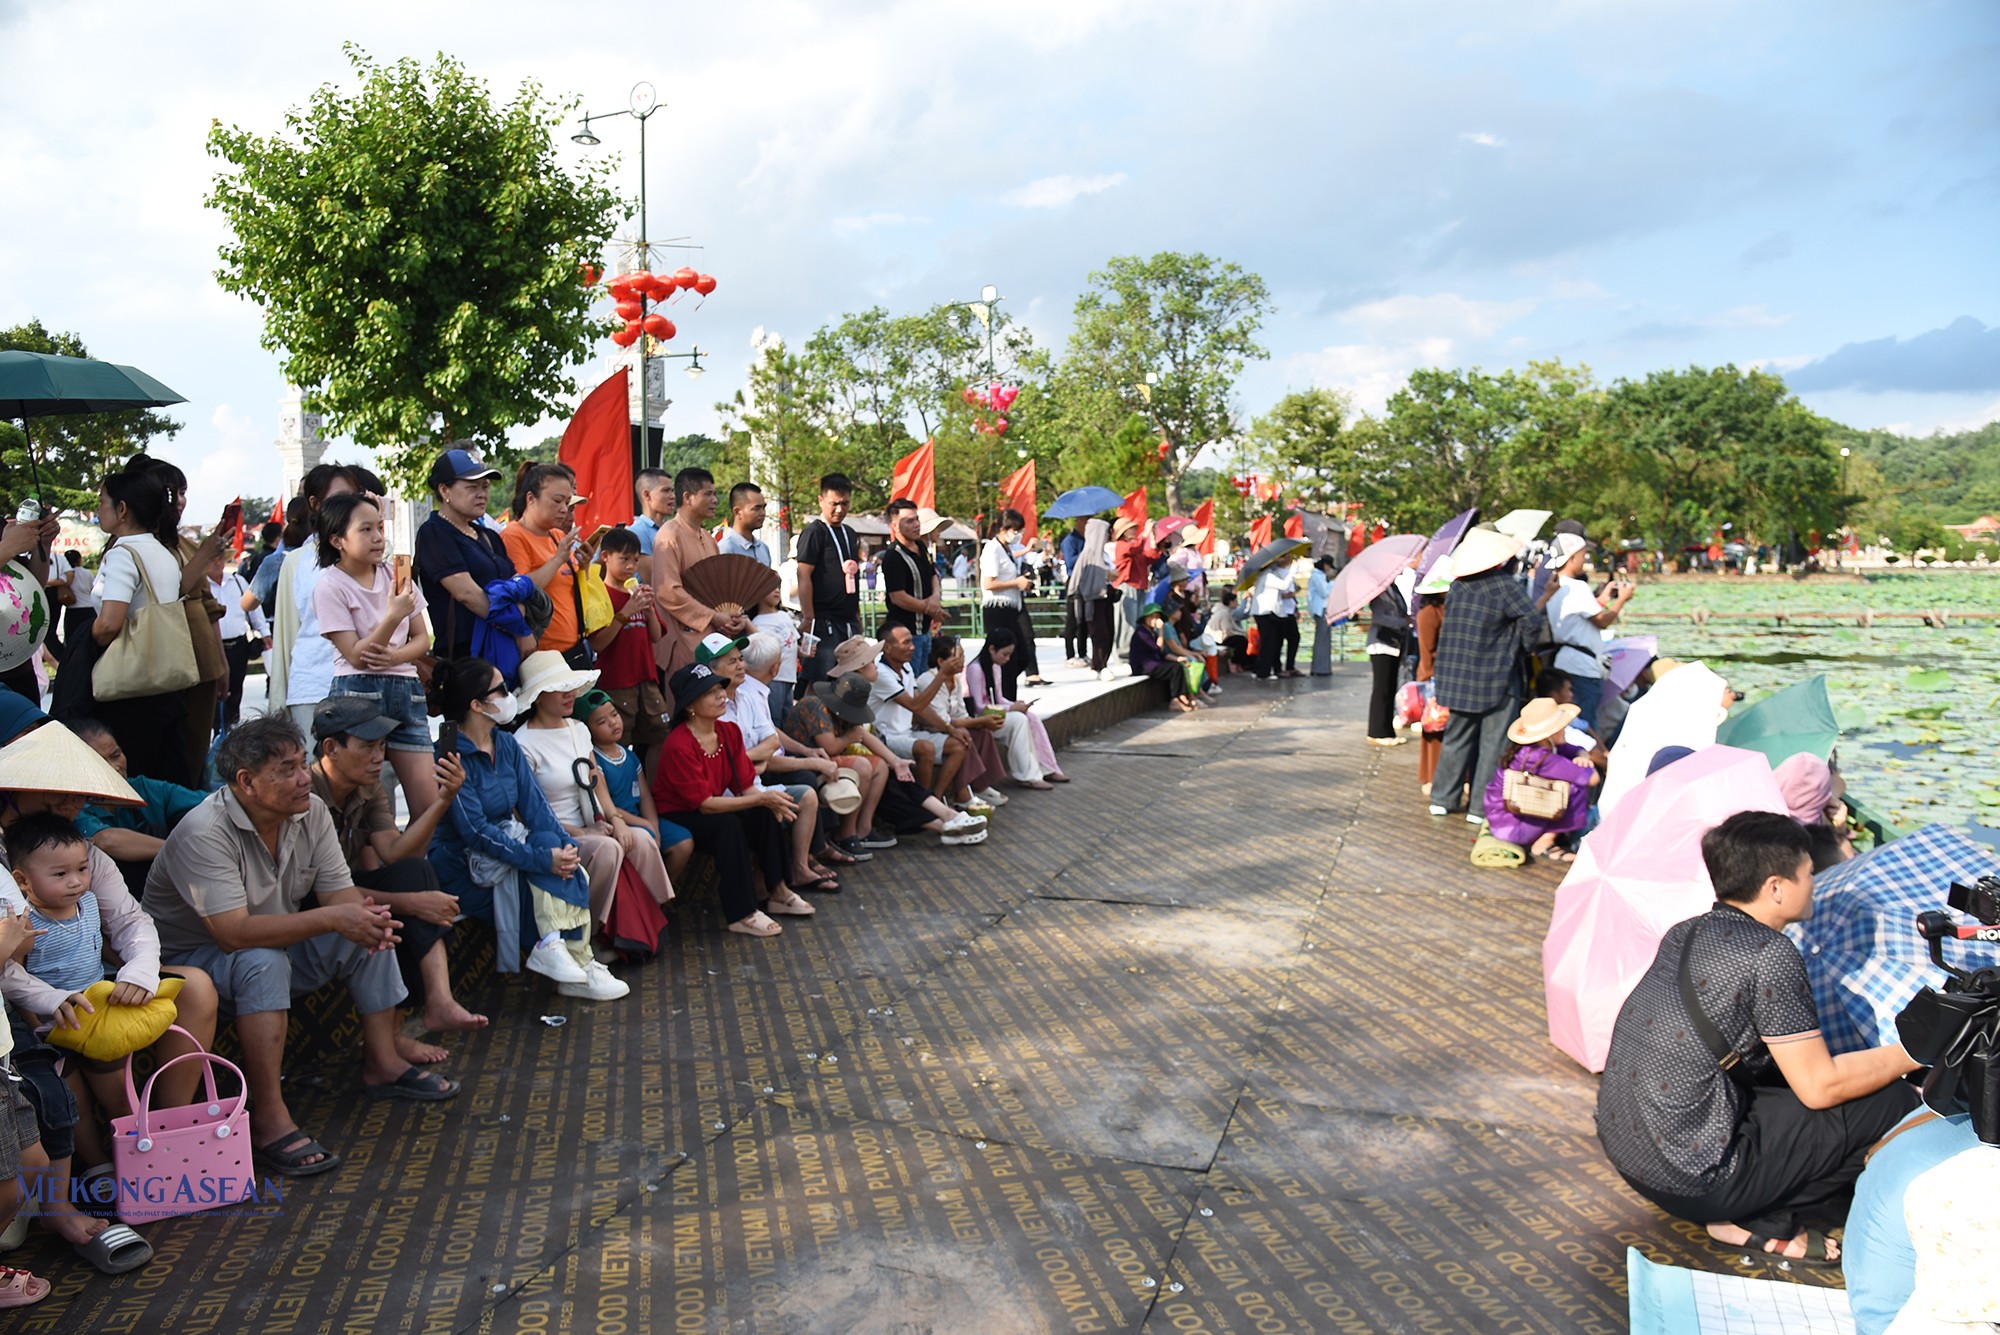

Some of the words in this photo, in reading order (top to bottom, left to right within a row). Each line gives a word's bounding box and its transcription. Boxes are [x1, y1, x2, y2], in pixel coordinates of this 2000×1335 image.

[398, 1133, 441, 1190] VIETNAM
[464, 1128, 500, 1186] VIETNAM
[733, 1138, 766, 1202] PLYWOOD
[793, 1133, 830, 1197] PLYWOOD
[851, 1128, 895, 1191] PLYWOOD
[442, 1190, 487, 1265] PLYWOOD
[516, 1184, 553, 1259] PLYWOOD
[1000, 1182, 1054, 1247] VIETNAM
[1061, 1175, 1120, 1237] VIETNAM
[1120, 1169, 1184, 1228] VIETNAM
[1357, 1195, 1444, 1261] VIETNAM
[1416, 1186, 1504, 1250] VIETNAM
[1471, 1178, 1565, 1242] VIETNAM
[1526, 1169, 1621, 1231] VIETNAM
[291, 1199, 350, 1278] PLYWOOD
[368, 1196, 419, 1272] PLYWOOD
[600, 1215, 632, 1292] VIETNAM
[674, 1212, 704, 1285] VIETNAM
[740, 1207, 776, 1278] VIETNAM
[1238, 1210, 1317, 1281] VIETNAM
[1299, 1203, 1381, 1271] VIETNAM
[1036, 1247, 1107, 1334] PLYWOOD
[1103, 1238, 1157, 1303] YWOOD
[1496, 1250, 1617, 1335] PLYWOOD
